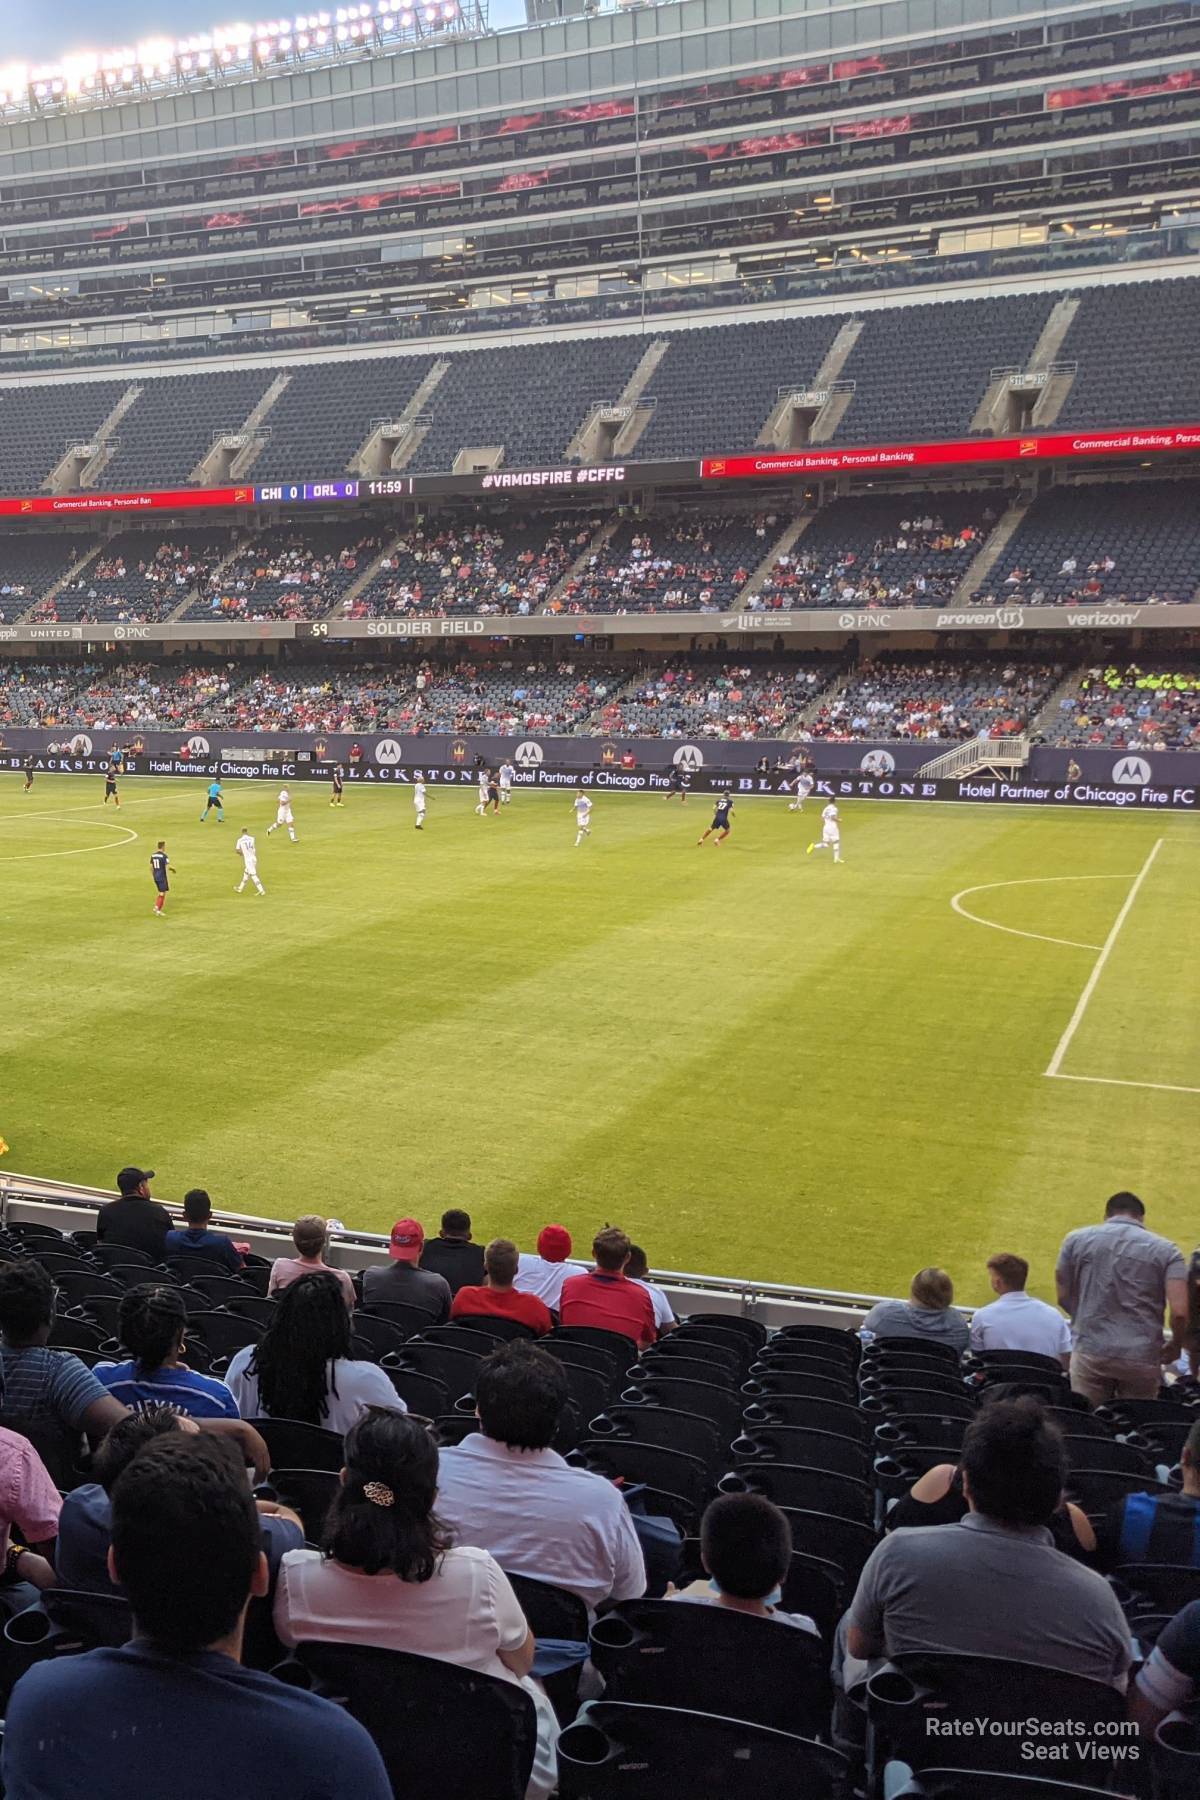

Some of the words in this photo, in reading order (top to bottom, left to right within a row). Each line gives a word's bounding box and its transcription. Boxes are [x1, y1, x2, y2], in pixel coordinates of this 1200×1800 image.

[1073, 437, 1130, 449] Commercial
[755, 458, 803, 470] Commercial
[841, 453, 878, 465] Personal
[880, 451, 914, 464] Banking
[482, 471, 572, 488] #VAMOSFIRE
[576, 467, 625, 482] #CFFC
[261, 487, 282, 500] CHI
[290, 486, 298, 499] 0
[313, 485, 337, 496] ORL
[345, 484, 353, 495] 0
[368, 481, 402, 494] 11:59
[858, 615, 891, 627] PNC
[937, 613, 996, 627] proven
[1067, 612, 1132, 626] verizon
[30, 630, 70, 638] UNITED
[127, 628, 151, 638] PNC
[367, 622, 432, 636] SOLDIER
[441, 621, 485, 634] FIELD
[10, 758, 136, 771] BACKSTOE
[150, 761, 173, 772] Hotel
[175, 762, 206, 773] Partner
[208, 761, 219, 773] of
[220, 762, 260, 777] Chicago
[262, 763, 280, 776] Fire
[281, 764, 295, 776] FC
[539, 772, 577, 784] Partner
[582, 772, 594, 784] of
[597, 773, 646, 788] Chicago
[650, 774, 670, 787] Fire
[710, 779, 733, 787] THE
[738, 778, 937, 796] BLAKSTONE
[959, 783, 996, 798] Hotel
[1000, 785, 1050, 800] Partner
[1054, 784, 1070, 800] of
[1074, 786, 1136, 805] Chicago
[1141, 788, 1168, 803] Fire
[1173, 790, 1195, 804] FC
[718, 801, 728, 811] 27
